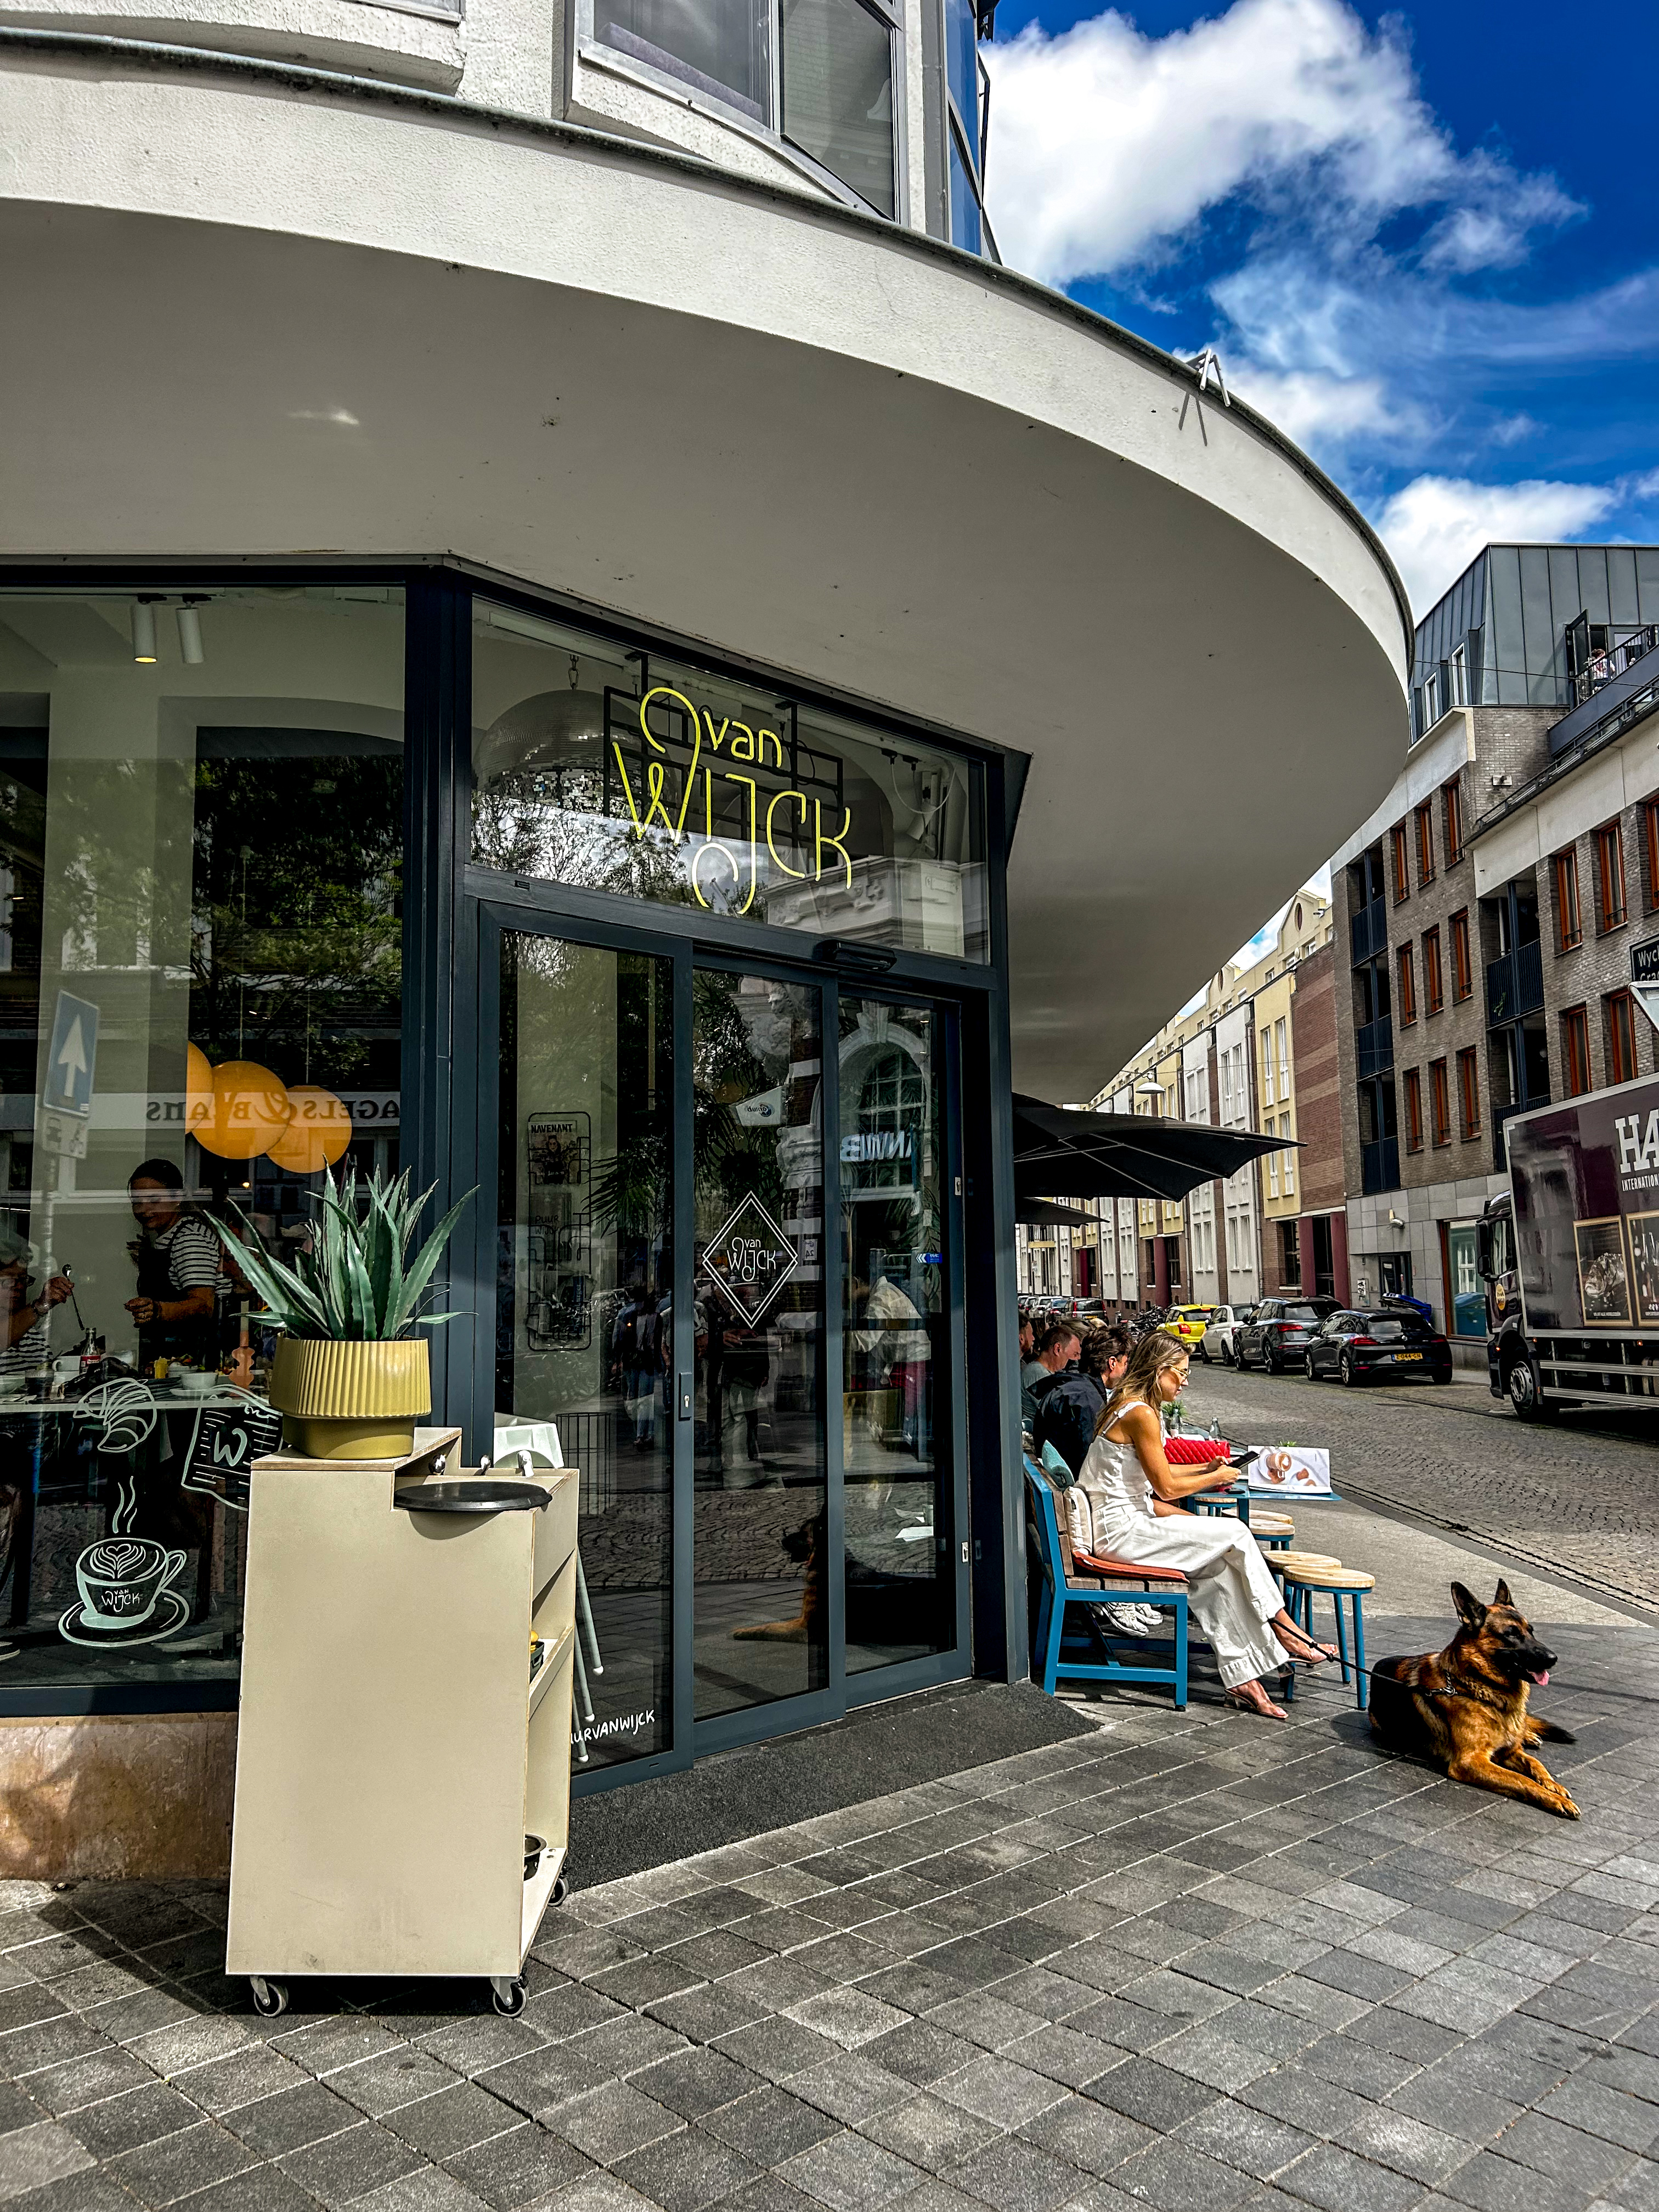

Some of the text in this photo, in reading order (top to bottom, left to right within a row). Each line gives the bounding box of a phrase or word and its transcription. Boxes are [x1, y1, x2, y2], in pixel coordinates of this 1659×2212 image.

[703, 710, 783, 768] van
[612, 686, 851, 915] WIJCK
[1638, 945, 1659, 968] Wyc
[1622, 1173, 1659, 1192] INTERNATION
[726, 1237, 776, 1282] WIJCK
[744, 1239, 761, 1248] van
[213, 1427, 248, 1467] W
